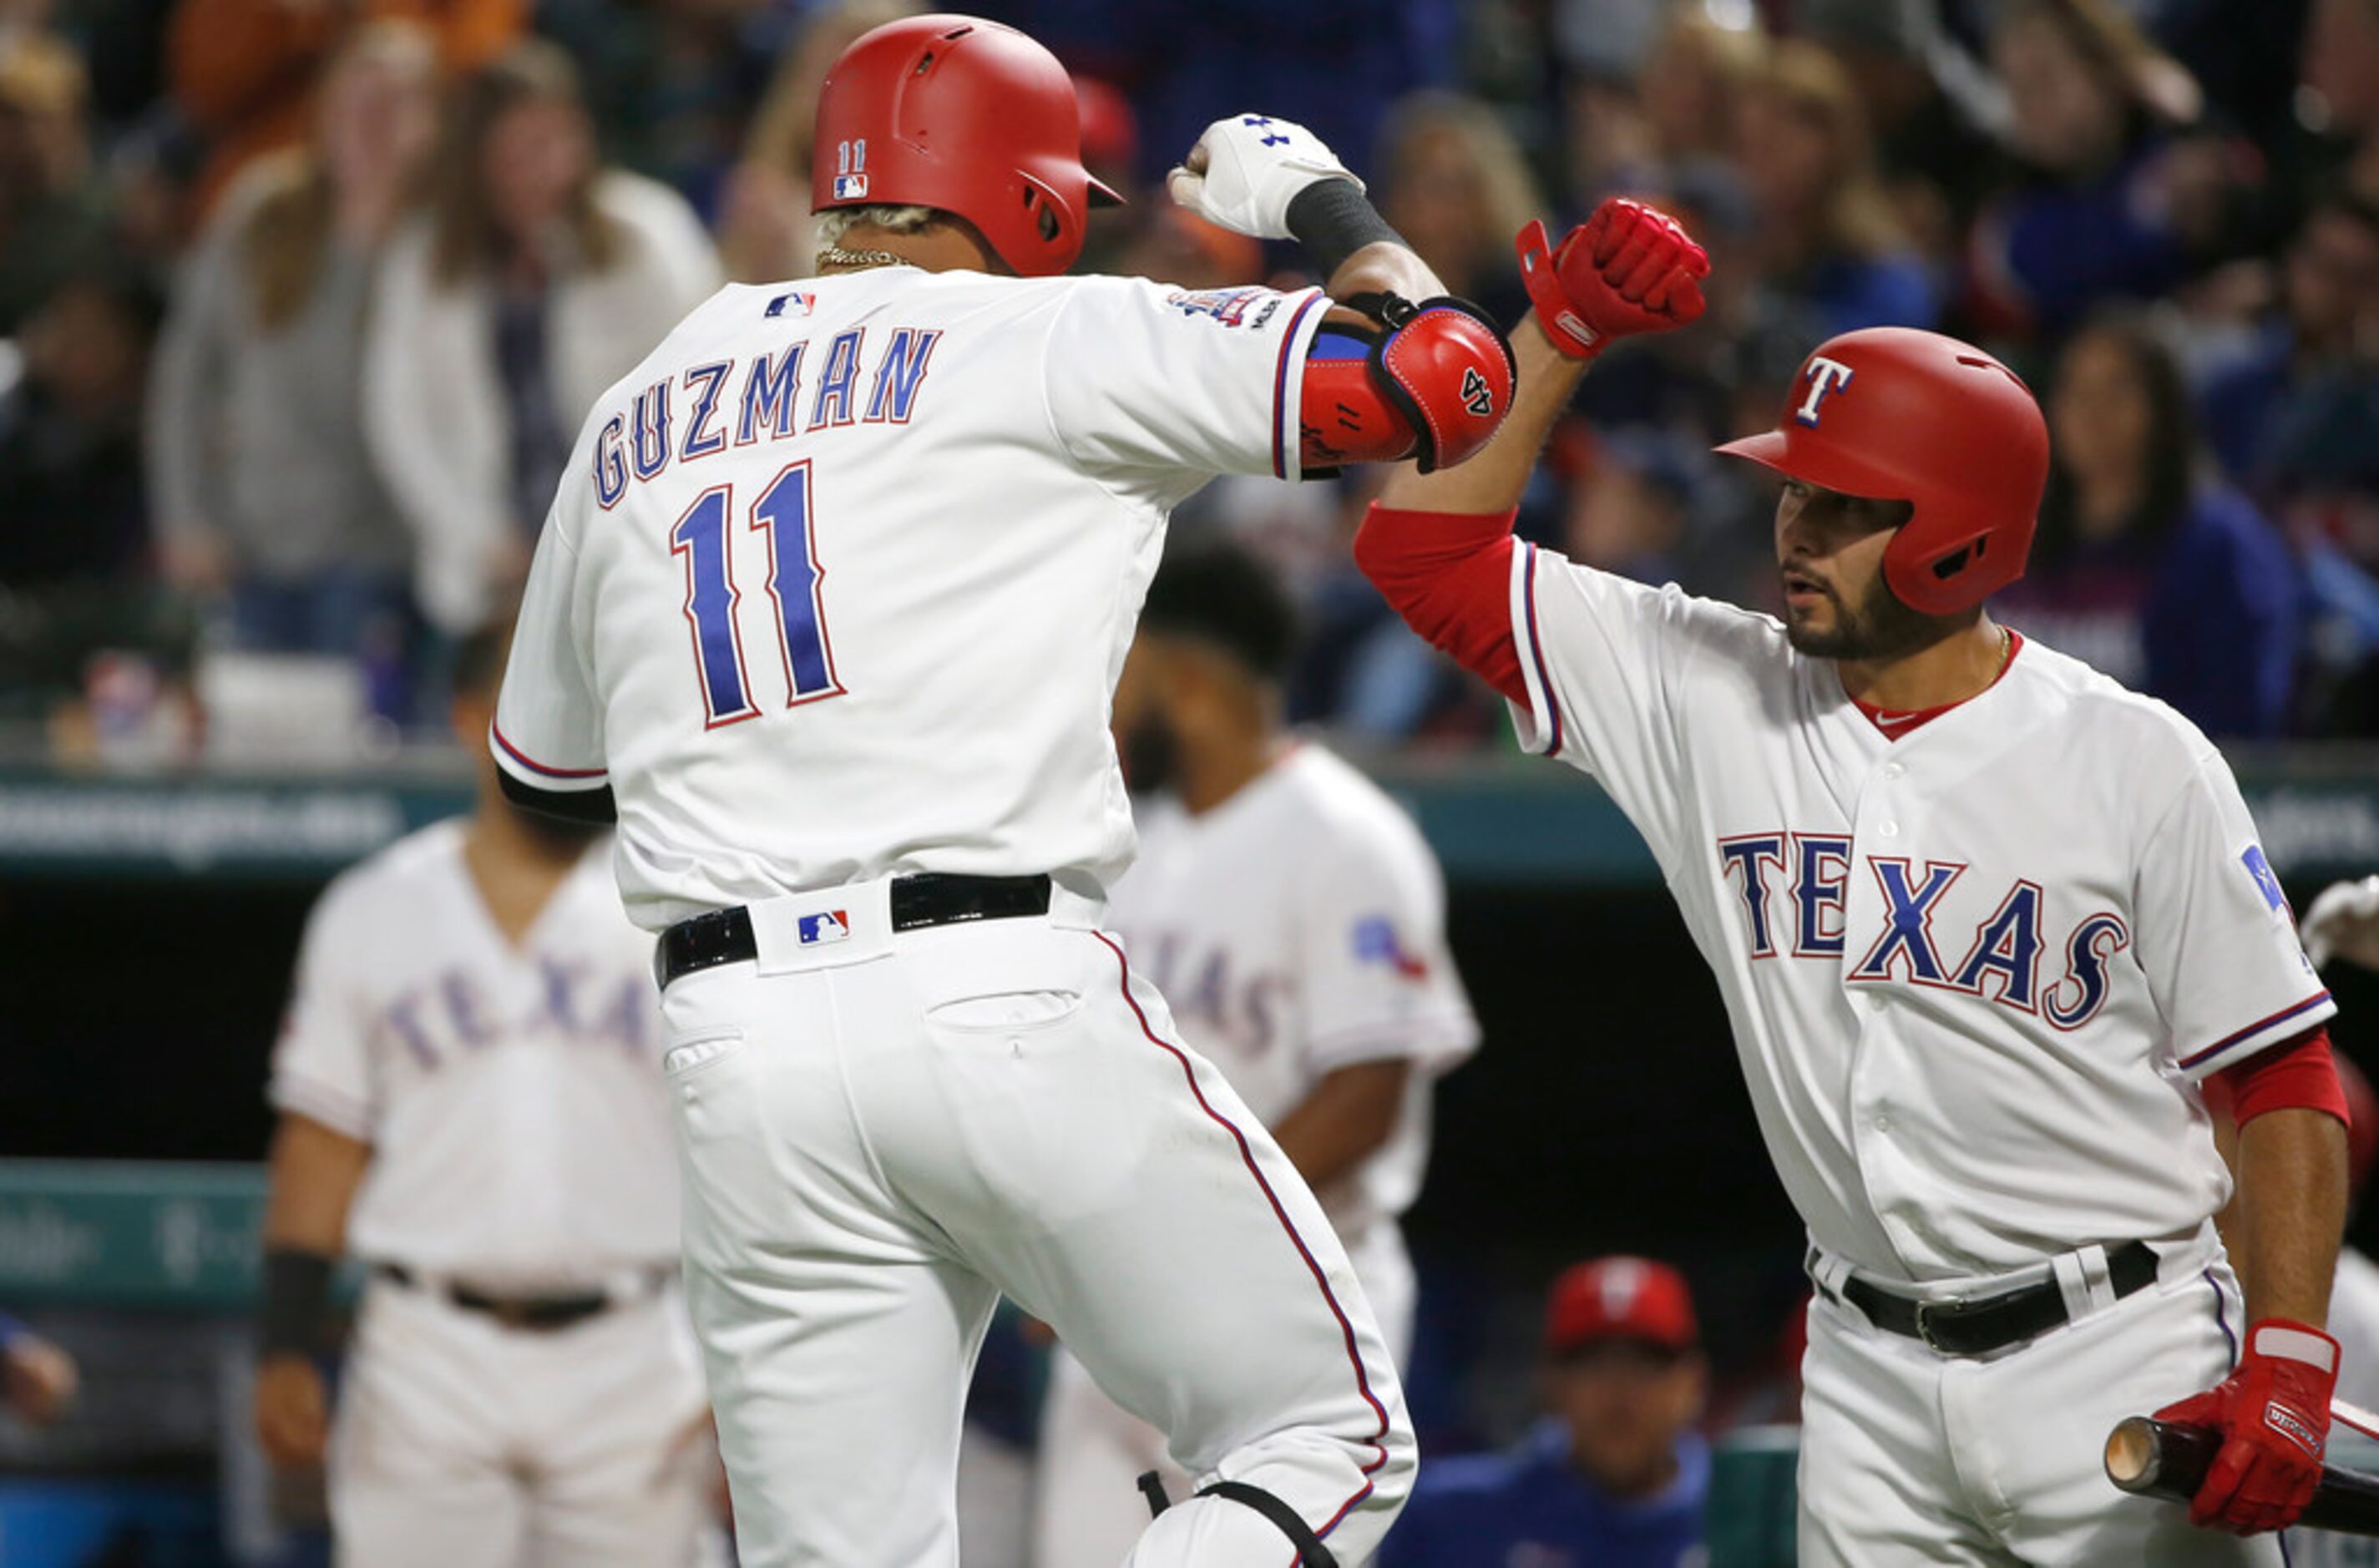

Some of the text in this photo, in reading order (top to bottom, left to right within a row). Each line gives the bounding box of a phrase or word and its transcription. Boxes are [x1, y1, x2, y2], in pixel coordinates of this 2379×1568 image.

[838, 139, 866, 175] 11
[592, 326, 944, 511] GUZMAN
[1796, 357, 1855, 429] T
[670, 458, 848, 731] 11
[1717, 831, 2129, 1032] TEXAS
